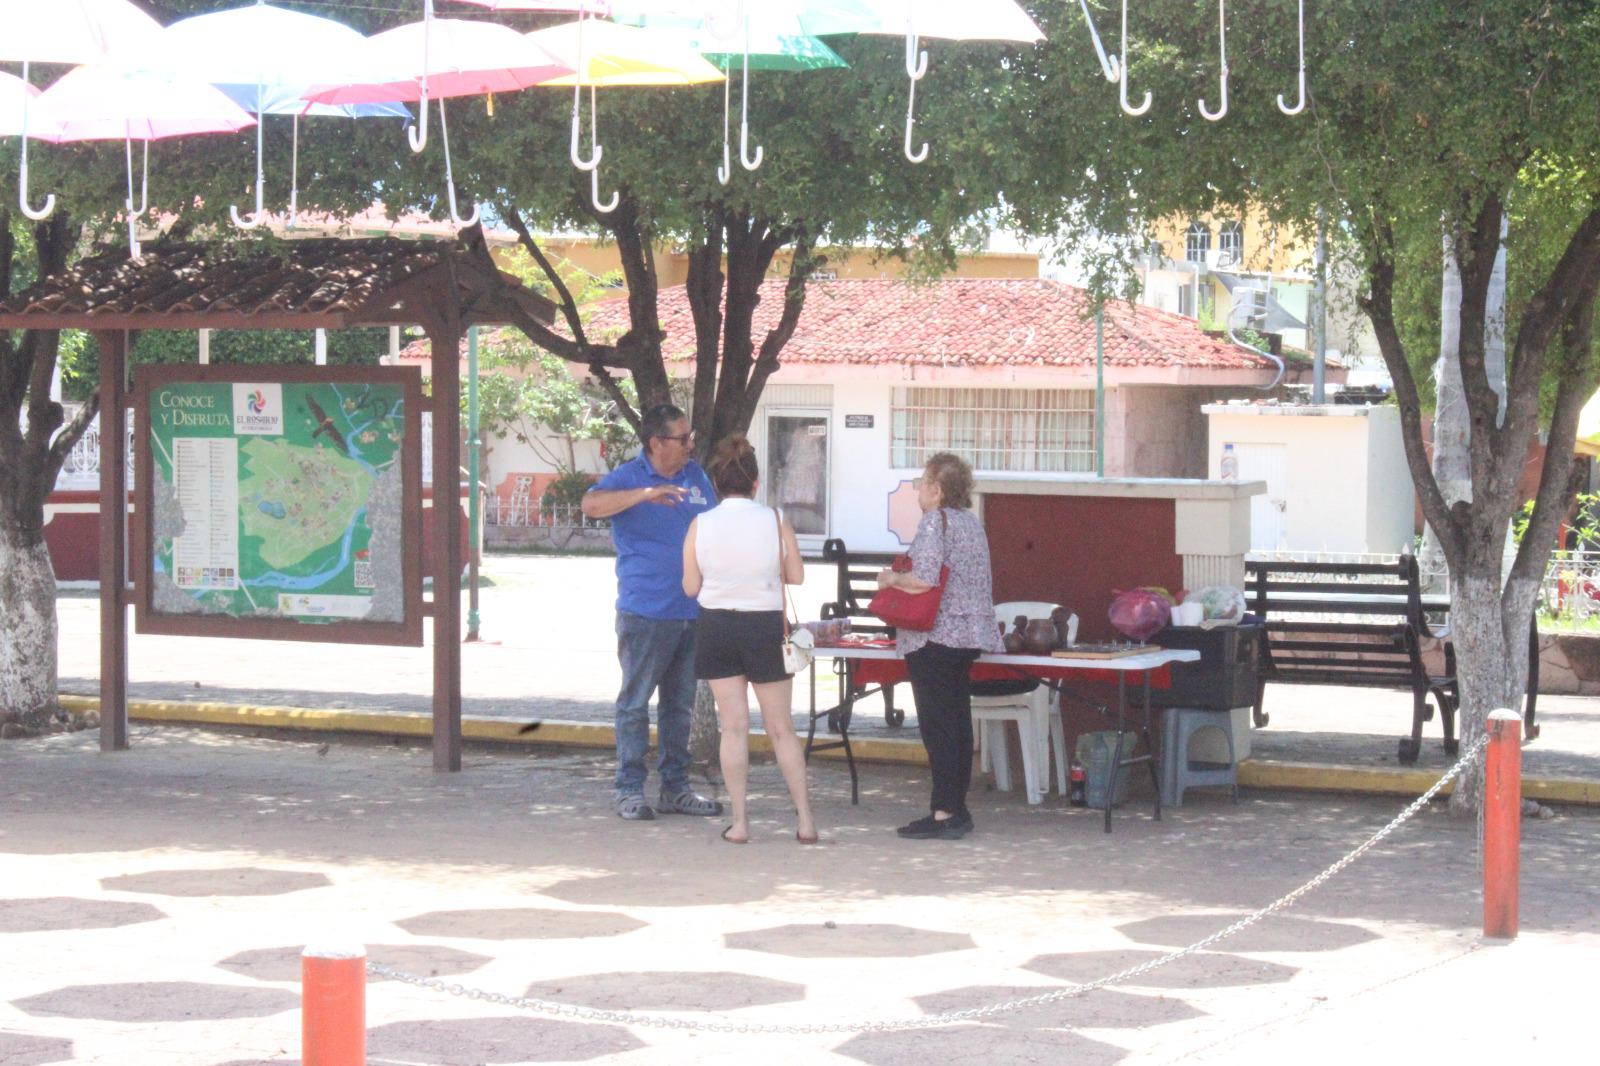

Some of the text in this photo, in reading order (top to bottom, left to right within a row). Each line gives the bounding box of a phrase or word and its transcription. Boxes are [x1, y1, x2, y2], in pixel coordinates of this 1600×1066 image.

[160, 391, 215, 408] CONOCE
[161, 409, 231, 426] Y DISFRUTA
[237, 415, 246, 424] EL
